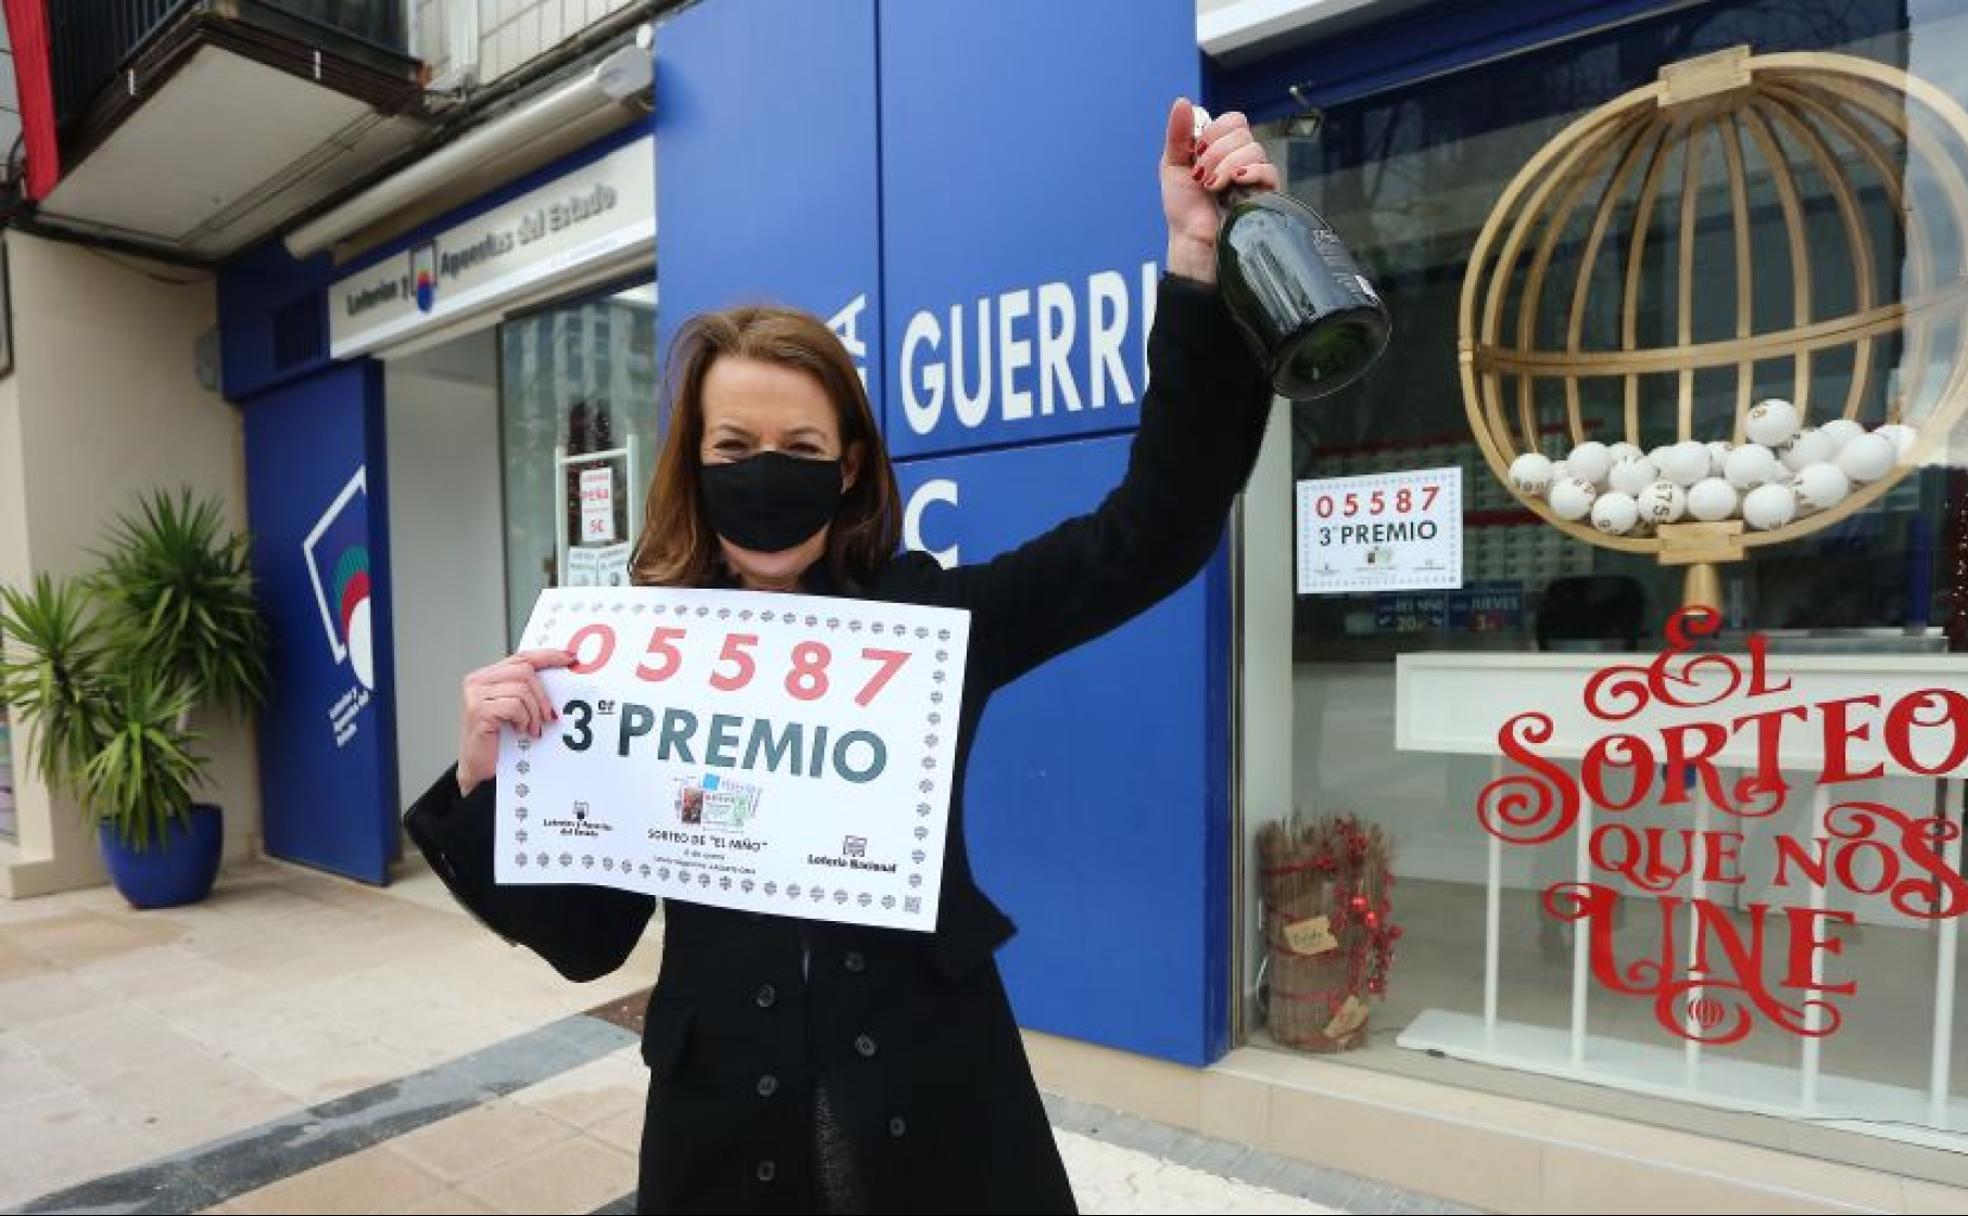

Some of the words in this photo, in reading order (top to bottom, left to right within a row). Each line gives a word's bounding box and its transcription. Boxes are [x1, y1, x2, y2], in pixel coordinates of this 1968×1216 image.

[517, 209, 545, 246] del
[550, 184, 618, 233] Estado
[1315, 485, 1440, 519] 05587
[1341, 519, 1438, 545] PREMIO
[565, 622, 913, 709] 05587
[617, 701, 888, 784] PREMIO
[647, 828, 689, 844] SORTEO
[691, 834, 706, 846] DE
[1588, 823, 1746, 891] QUE
[1773, 802, 1968, 919] NOS
[1542, 881, 1858, 1045] UNE
